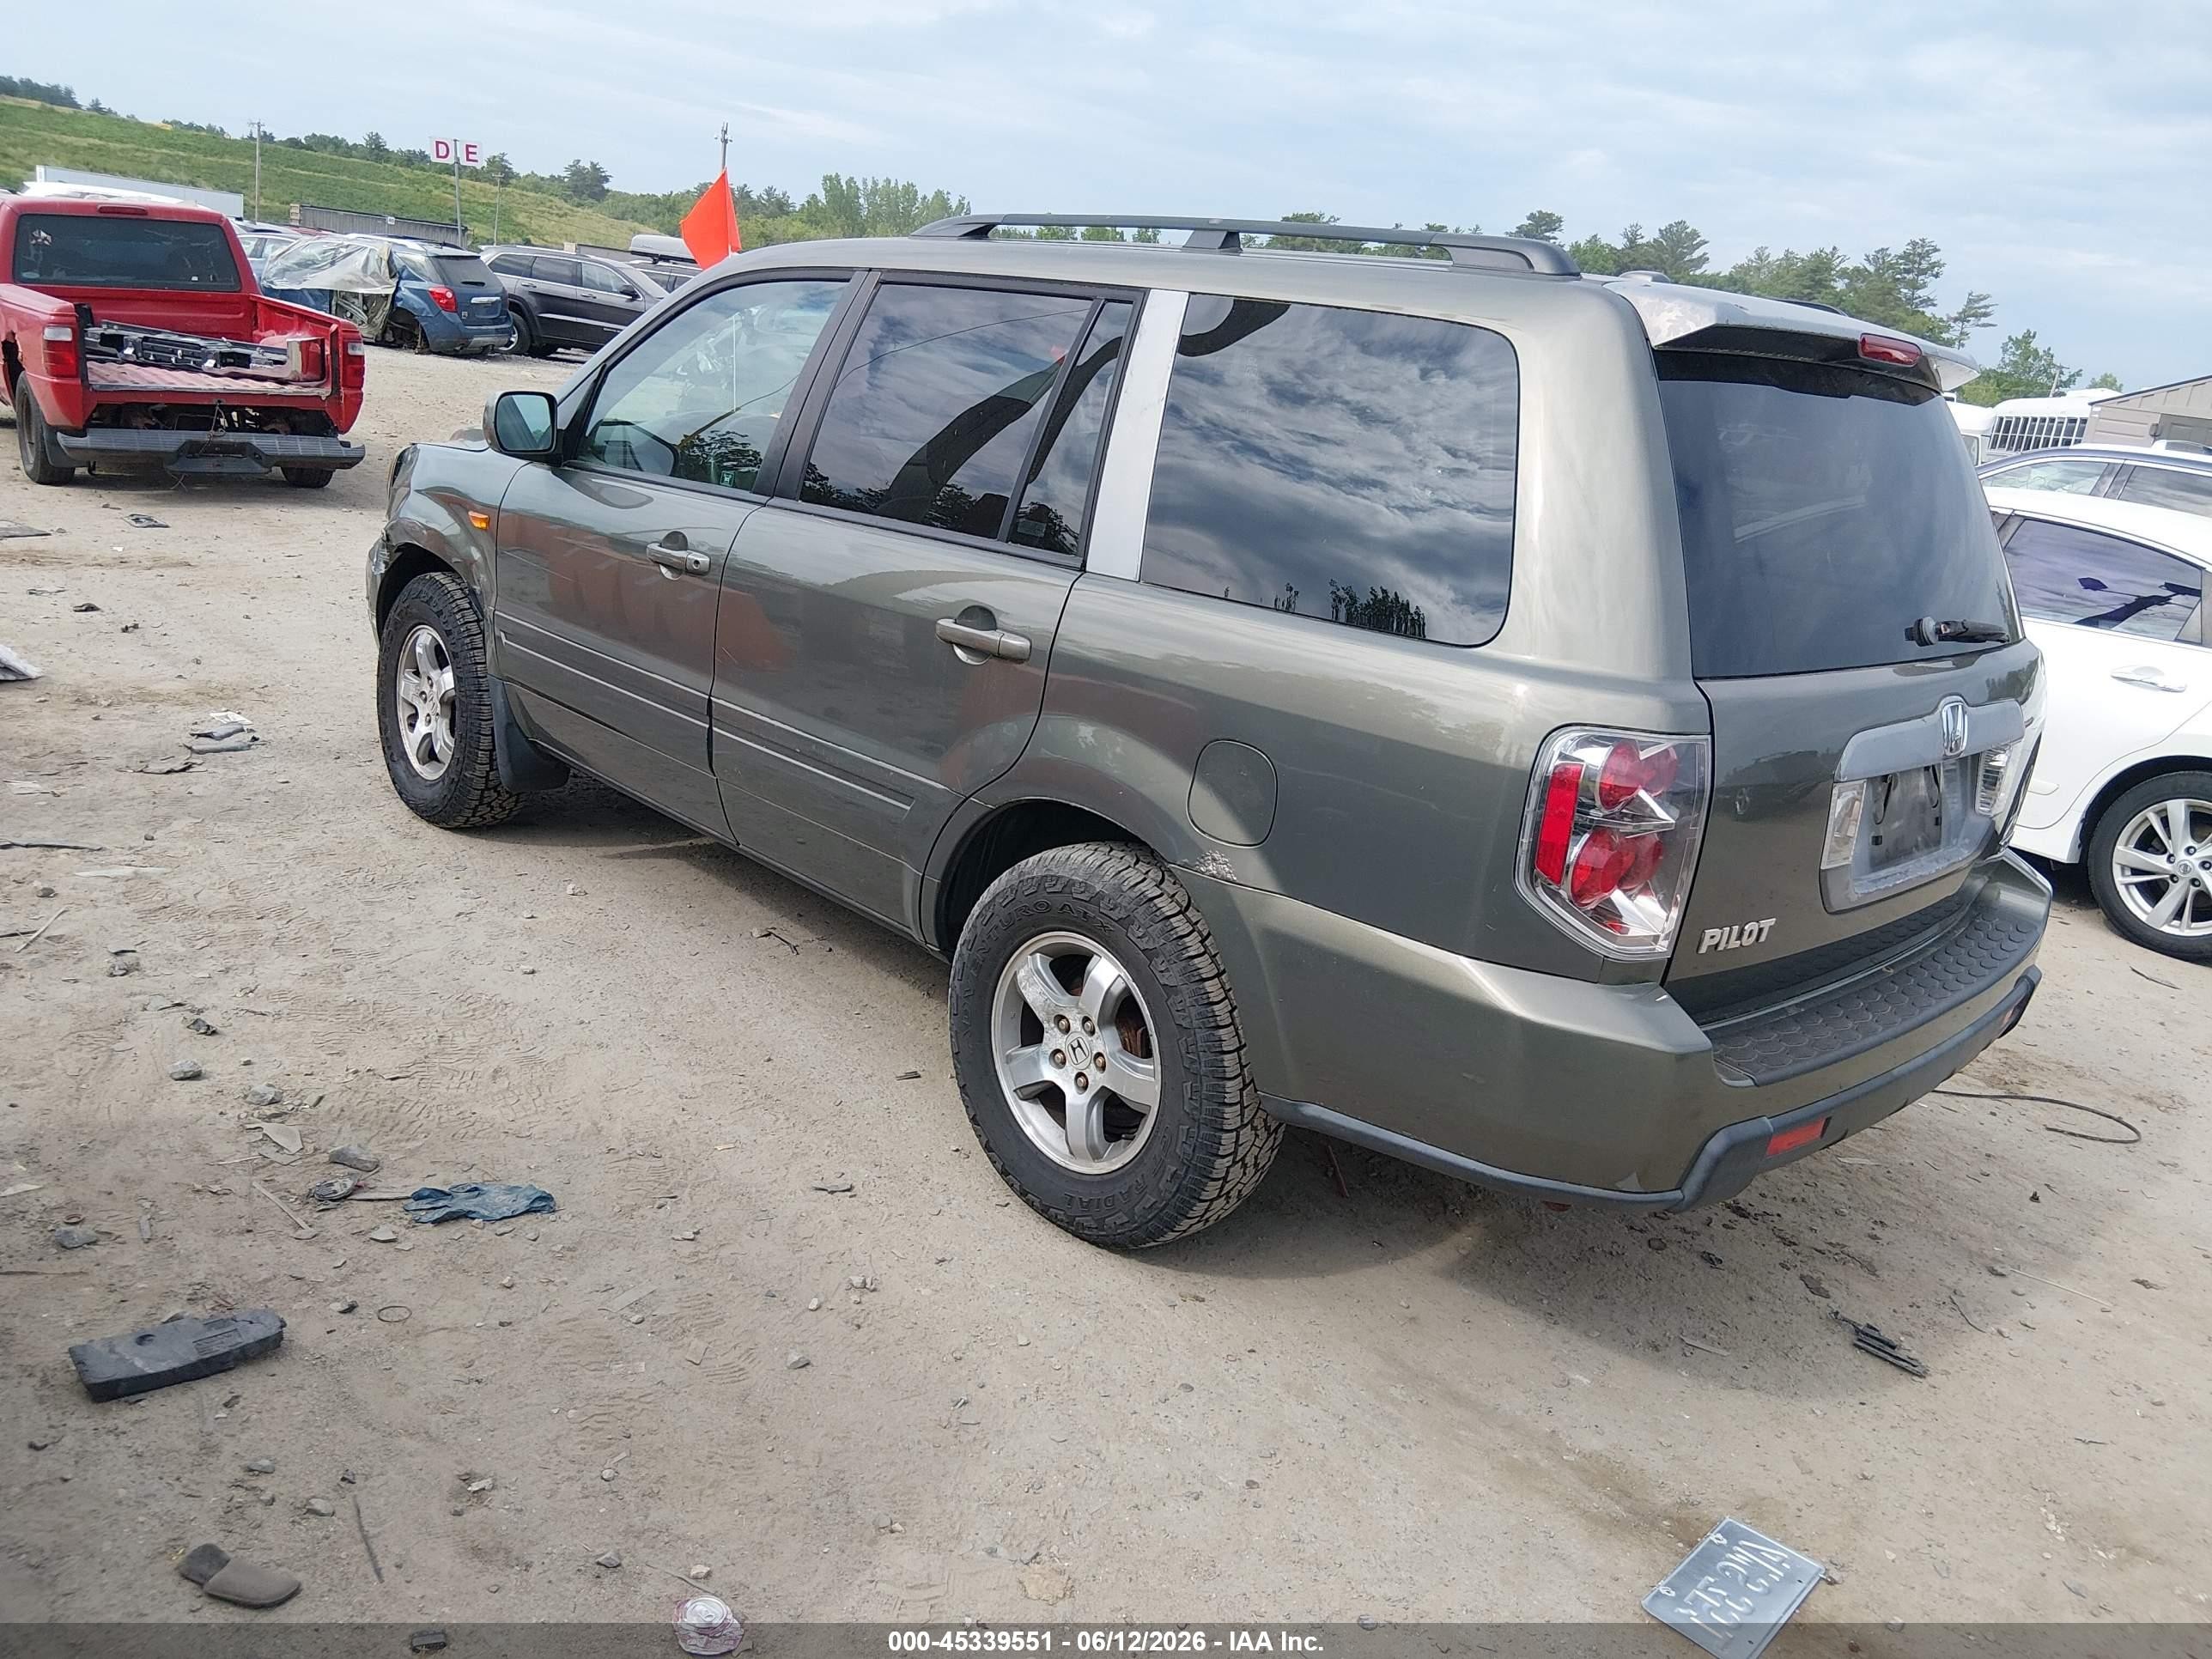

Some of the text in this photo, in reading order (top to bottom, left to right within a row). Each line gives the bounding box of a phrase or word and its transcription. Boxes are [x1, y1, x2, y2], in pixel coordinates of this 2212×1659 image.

[434, 140, 450, 160] D
[465, 143, 479, 163] E
[1698, 917, 1777, 954] PILOT
